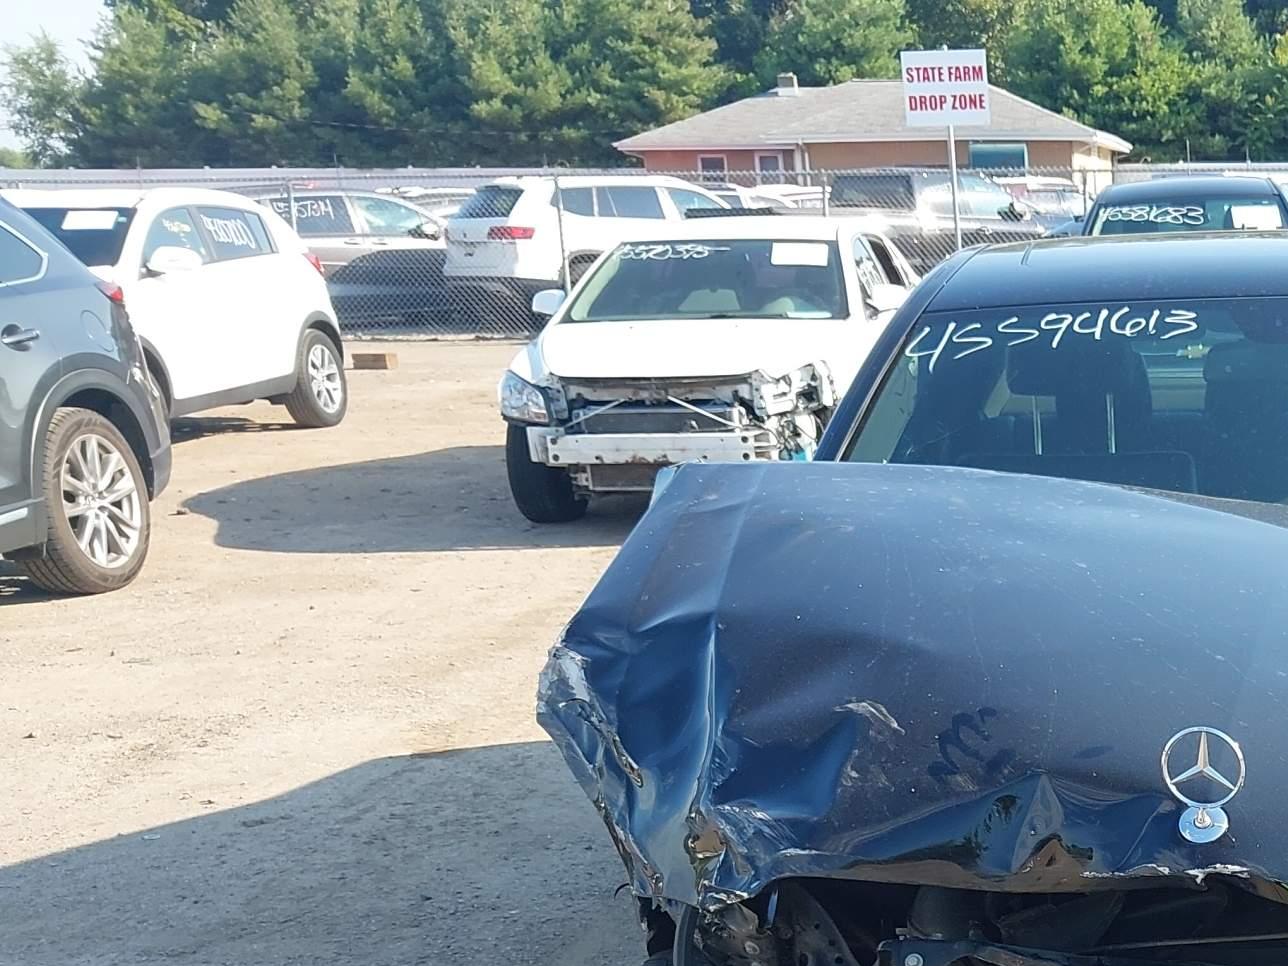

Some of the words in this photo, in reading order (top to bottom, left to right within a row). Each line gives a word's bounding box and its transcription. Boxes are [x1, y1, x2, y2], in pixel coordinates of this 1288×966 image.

[906, 67, 944, 82] STATE
[947, 66, 983, 81] FARM
[909, 95, 947, 111] DROP
[951, 94, 985, 110] ZONE
[904, 306, 1198, 374] 45594613
